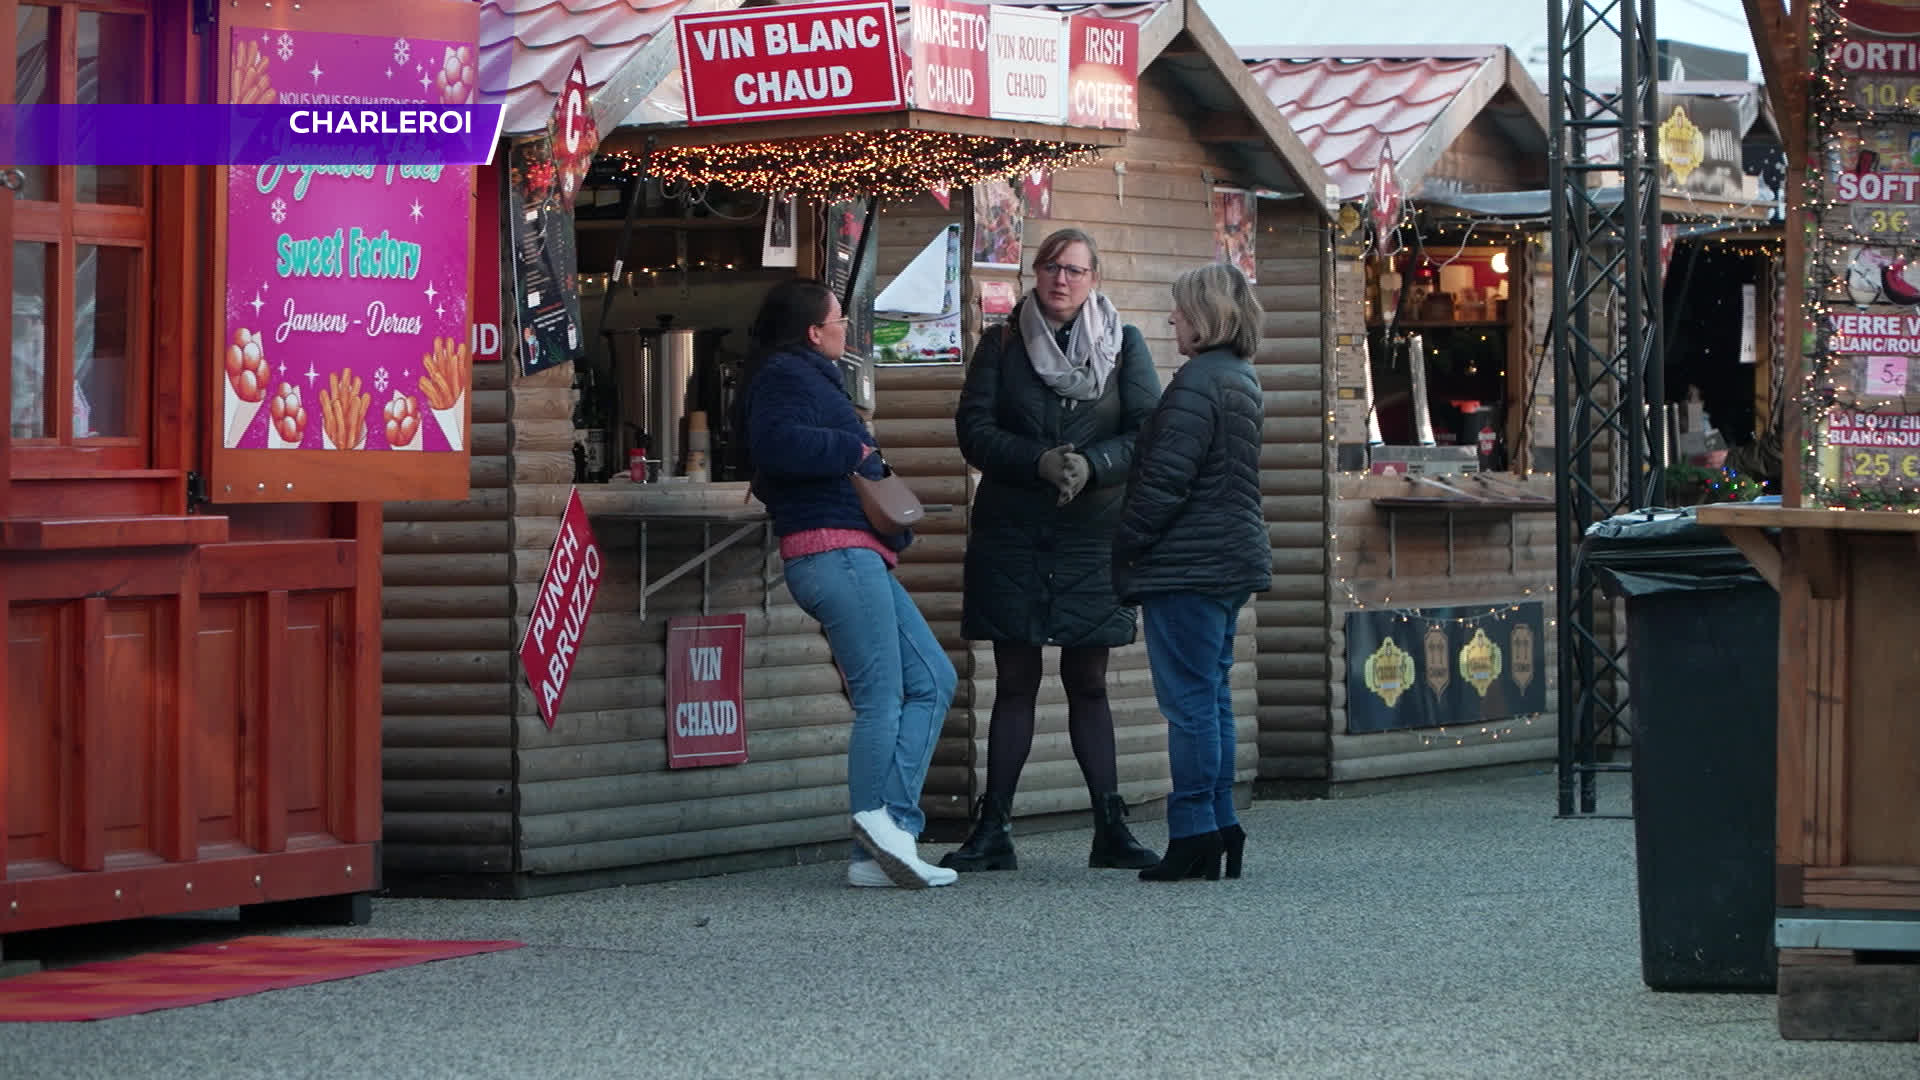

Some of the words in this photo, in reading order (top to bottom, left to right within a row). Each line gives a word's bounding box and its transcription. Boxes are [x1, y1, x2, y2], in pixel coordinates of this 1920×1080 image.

[694, 26, 756, 61] VIN
[764, 15, 881, 56] BLANC
[913, 4, 987, 51] AMARETTO
[1085, 26, 1125, 65] IRISH
[996, 34, 1014, 59] VIN
[1019, 36, 1057, 63] ROUGE
[734, 66, 854, 106] CHAUD
[927, 63, 974, 106] CHAUD
[1006, 72, 1048, 99] CHAUD
[1074, 79, 1134, 120] COFFEE
[1861, 84, 1897, 107] 10
[1871, 210, 1908, 234] 3€
[276, 228, 344, 278] Sweet
[349, 227, 421, 280] Factory
[275, 298, 349, 343] Janssens
[366, 300, 423, 336] Deraes
[1829, 315, 1901, 336] VERRE
[1830, 413, 1850, 428] LA
[1855, 453, 1891, 477] 25
[1902, 455, 1919, 478] €
[533, 523, 579, 655] PUNCH
[541, 544, 601, 717] ABRUZZO
[688, 646, 723, 682] VIN
[675, 700, 738, 738] CHAUD
